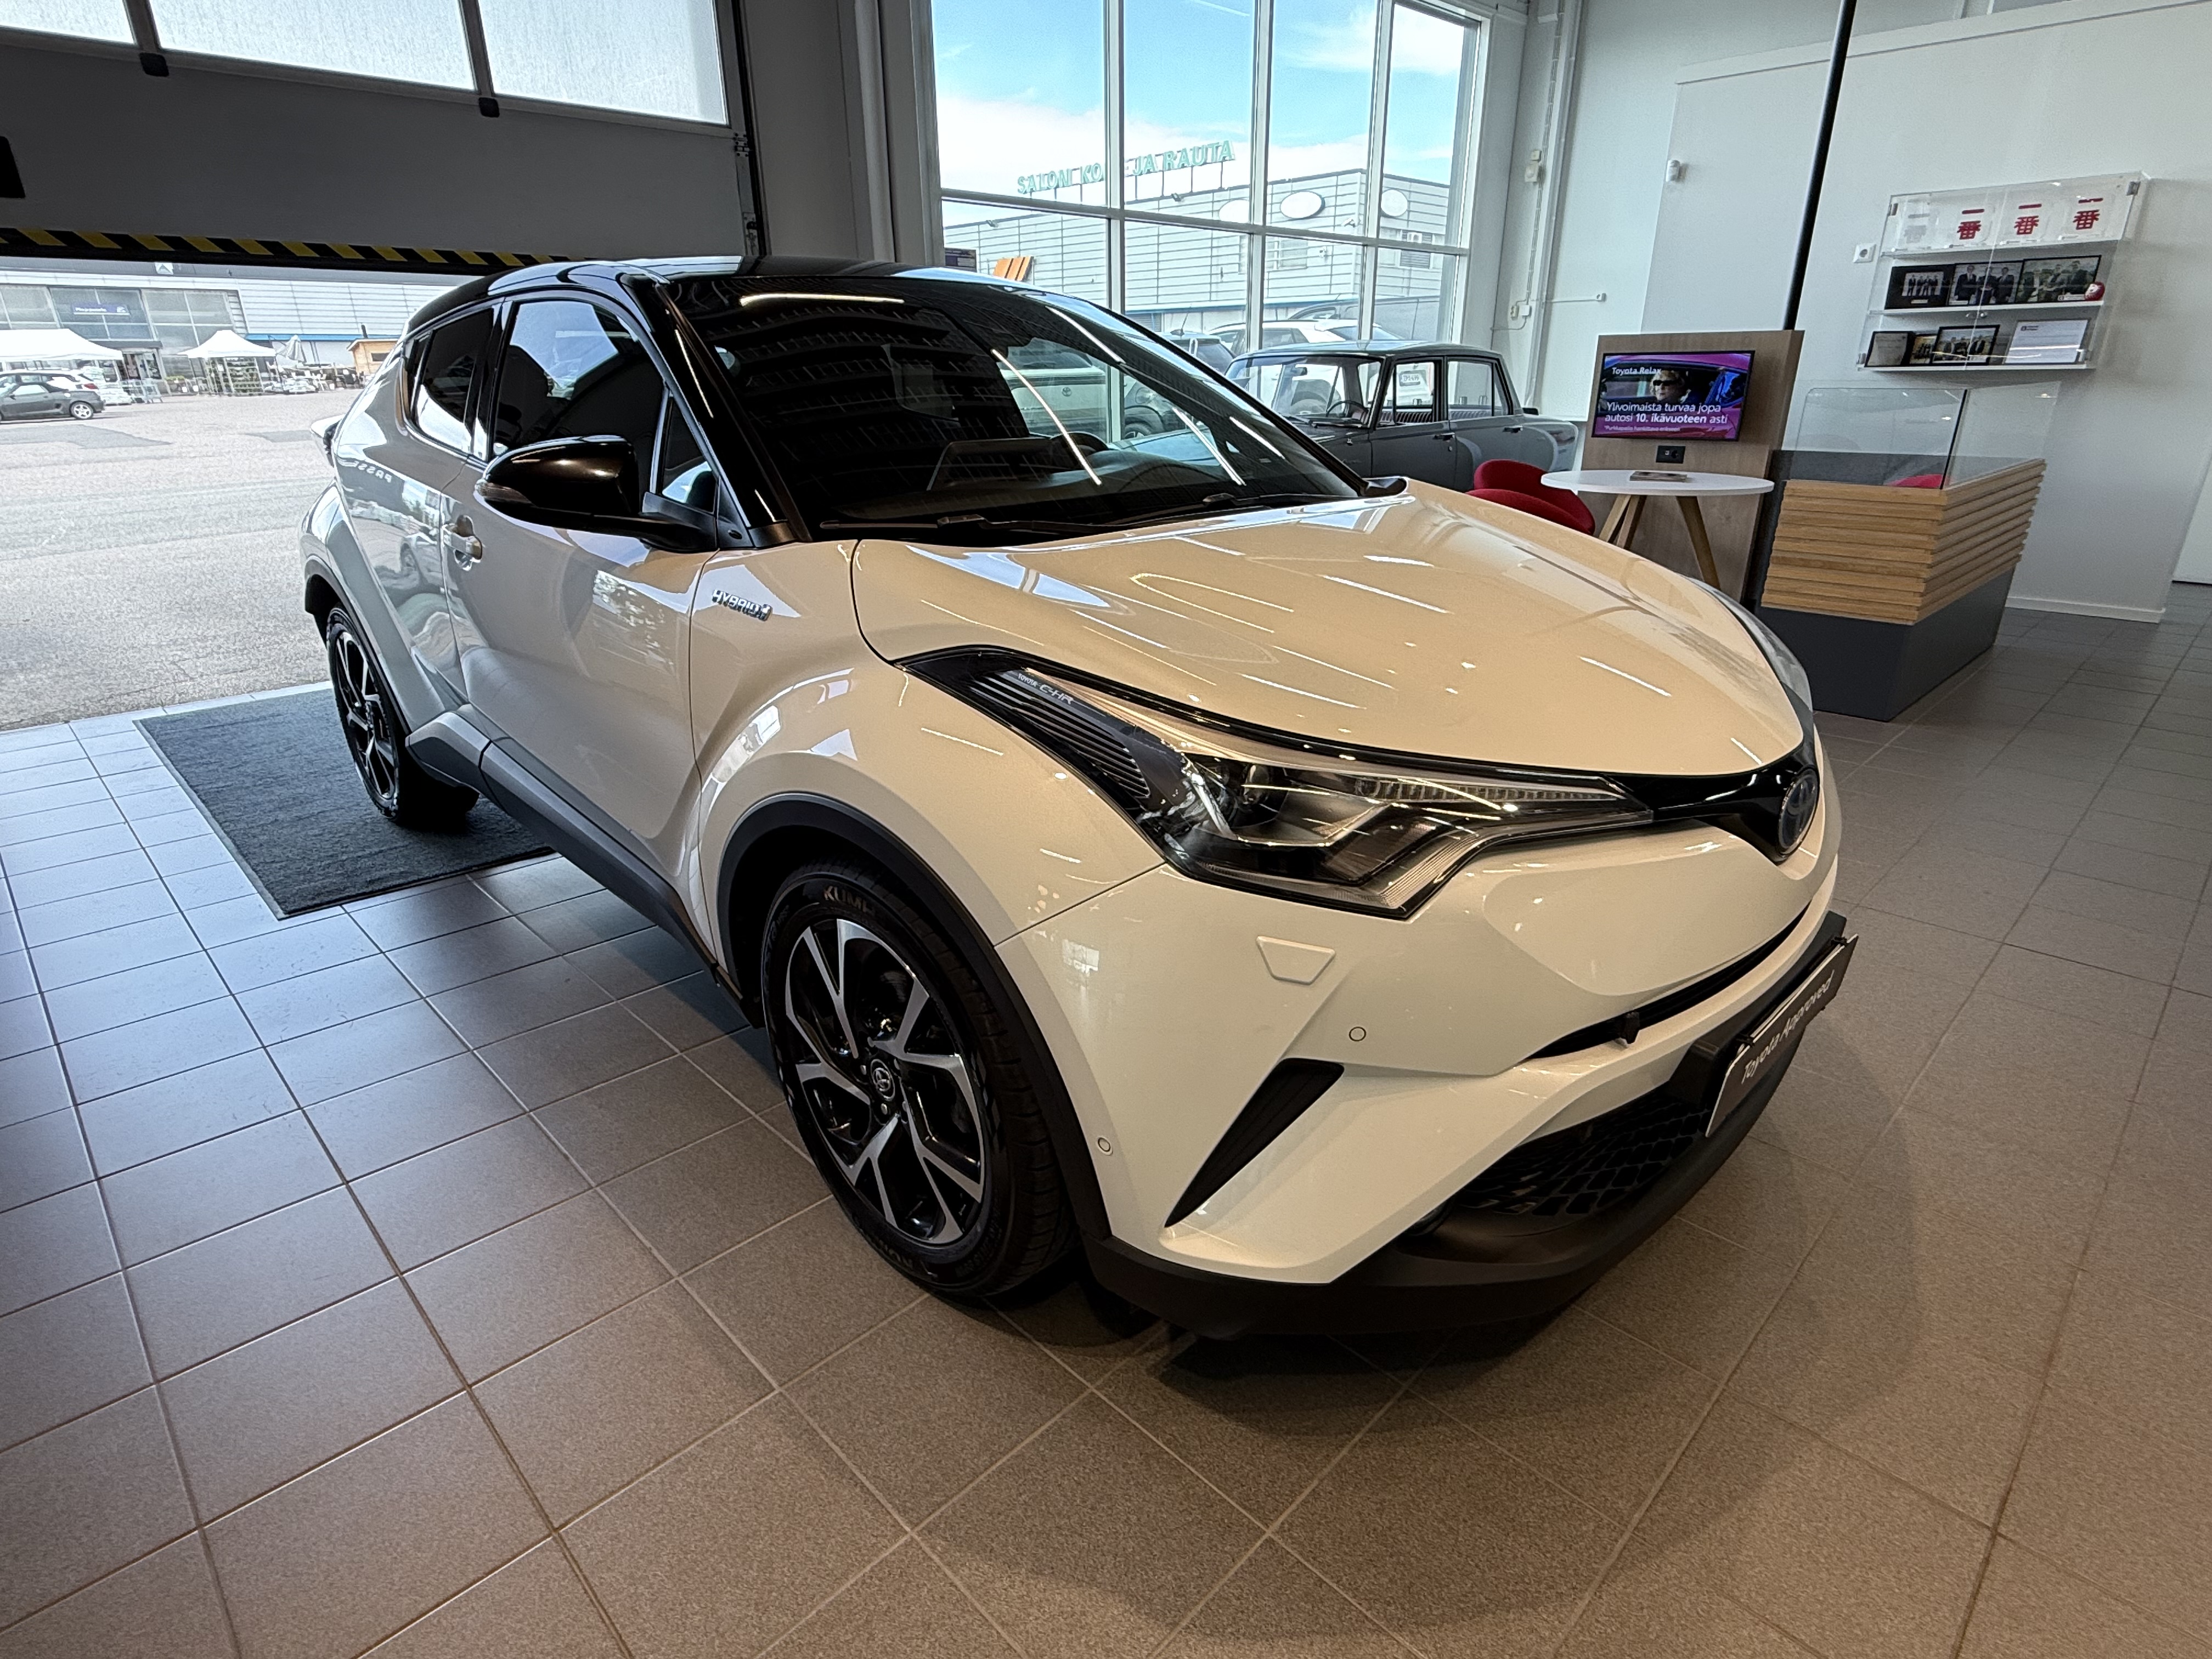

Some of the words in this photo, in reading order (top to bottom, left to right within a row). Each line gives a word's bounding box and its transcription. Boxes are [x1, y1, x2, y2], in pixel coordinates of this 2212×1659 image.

[1018, 168, 1073, 194] SALON
[1133, 154, 1158, 176] JA
[1163, 140, 1235, 171] RAUTA
[1612, 367, 1638, 376] Toyota
[1605, 413, 1633, 422] autosi
[1636, 414, 1649, 422] 10.
[1651, 413, 1707, 424] ikävuoteen
[1709, 415, 1728, 424] asti
[1607, 402, 1662, 412] Ylivoimaista
[1664, 403, 1695, 412] turvaa
[1698, 403, 1721, 414] jopa
[1018, 673, 1038, 687] TOYOTA
[1040, 684, 1074, 704] C-HR
[1741, 1033, 1780, 1084] Toyota
[1779, 969, 1835, 1042] Approved
